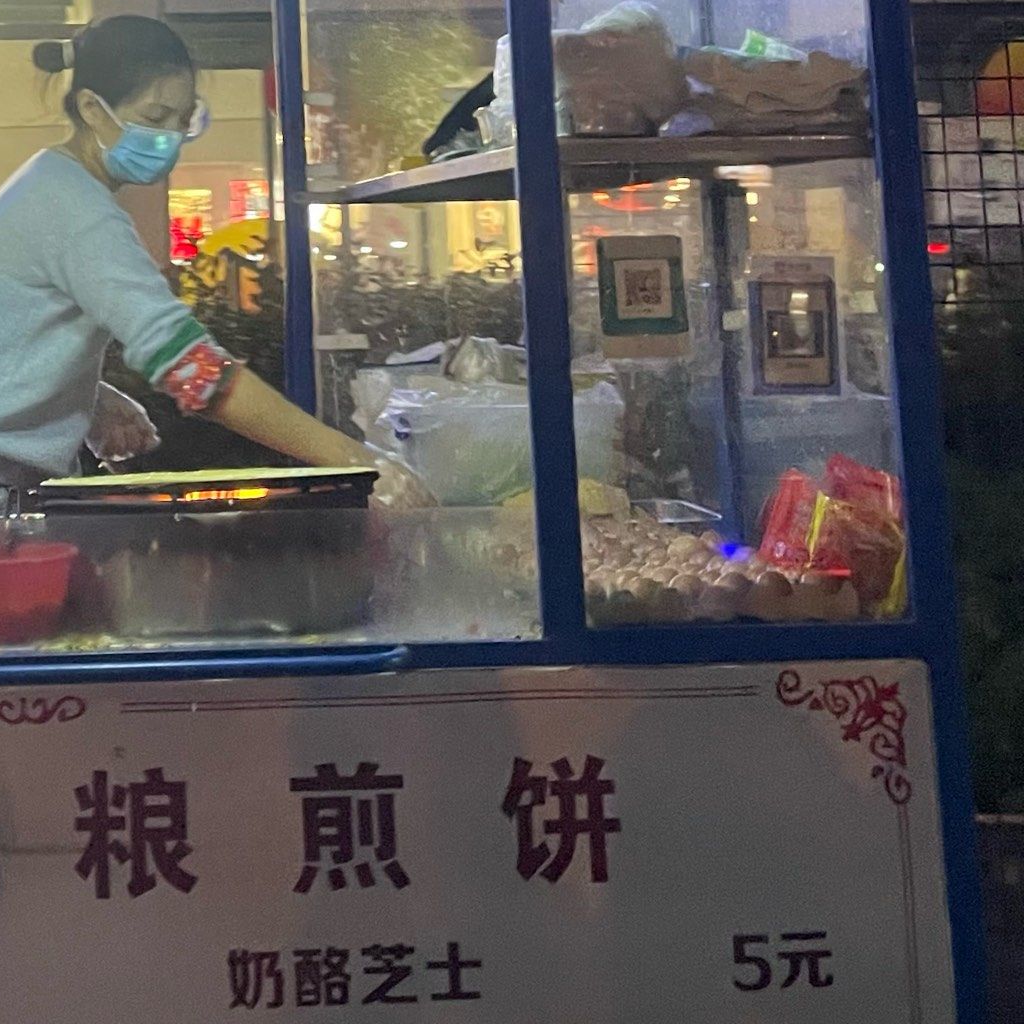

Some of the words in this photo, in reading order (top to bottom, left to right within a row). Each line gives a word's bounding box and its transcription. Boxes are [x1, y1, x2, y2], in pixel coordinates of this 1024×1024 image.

[228, 942, 484, 1010] 奶酪芝士
[731, 930, 835, 992] 5元
